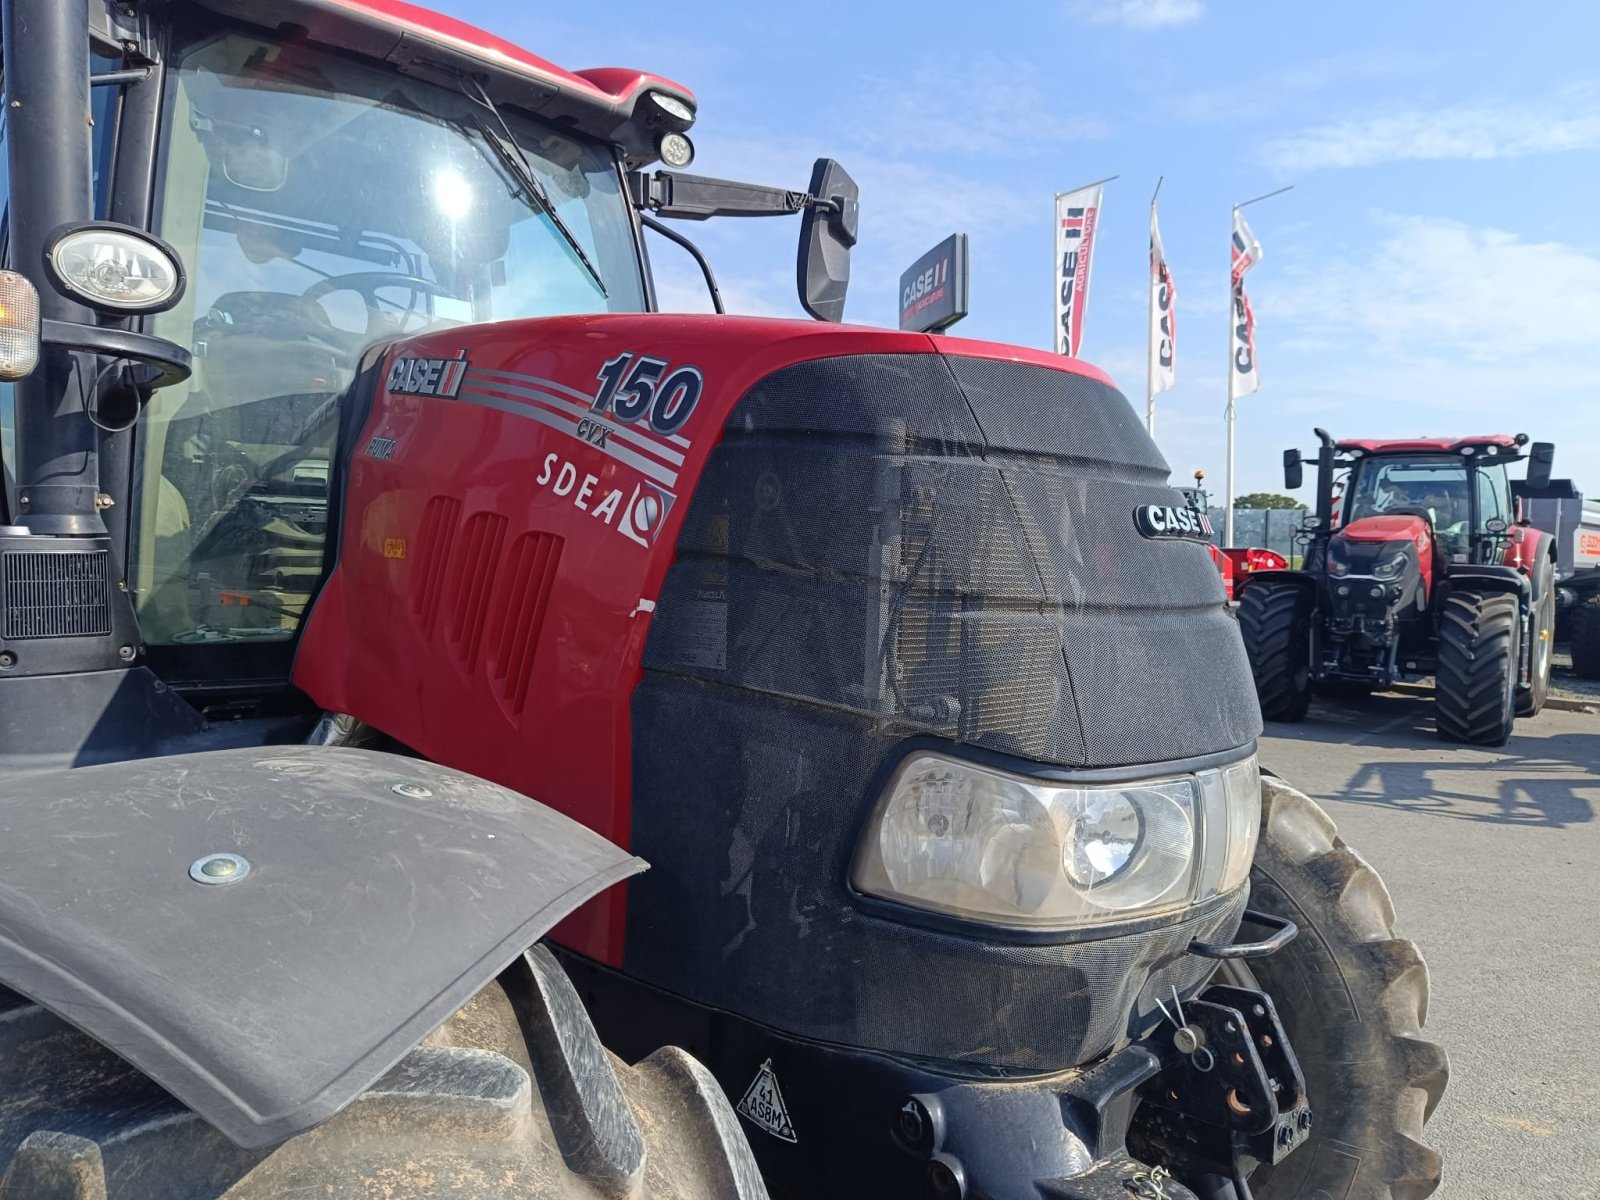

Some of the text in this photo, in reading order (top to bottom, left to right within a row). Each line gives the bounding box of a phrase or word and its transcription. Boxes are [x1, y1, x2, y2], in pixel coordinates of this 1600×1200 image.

[903, 267, 934, 309] CASE
[387, 358, 445, 394] CASE
[588, 352, 703, 436] 150
[576, 417, 615, 449] CVX
[536, 453, 623, 525] SDEA
[1148, 505, 1200, 532] CASE
[760, 1085, 773, 1106] 41
